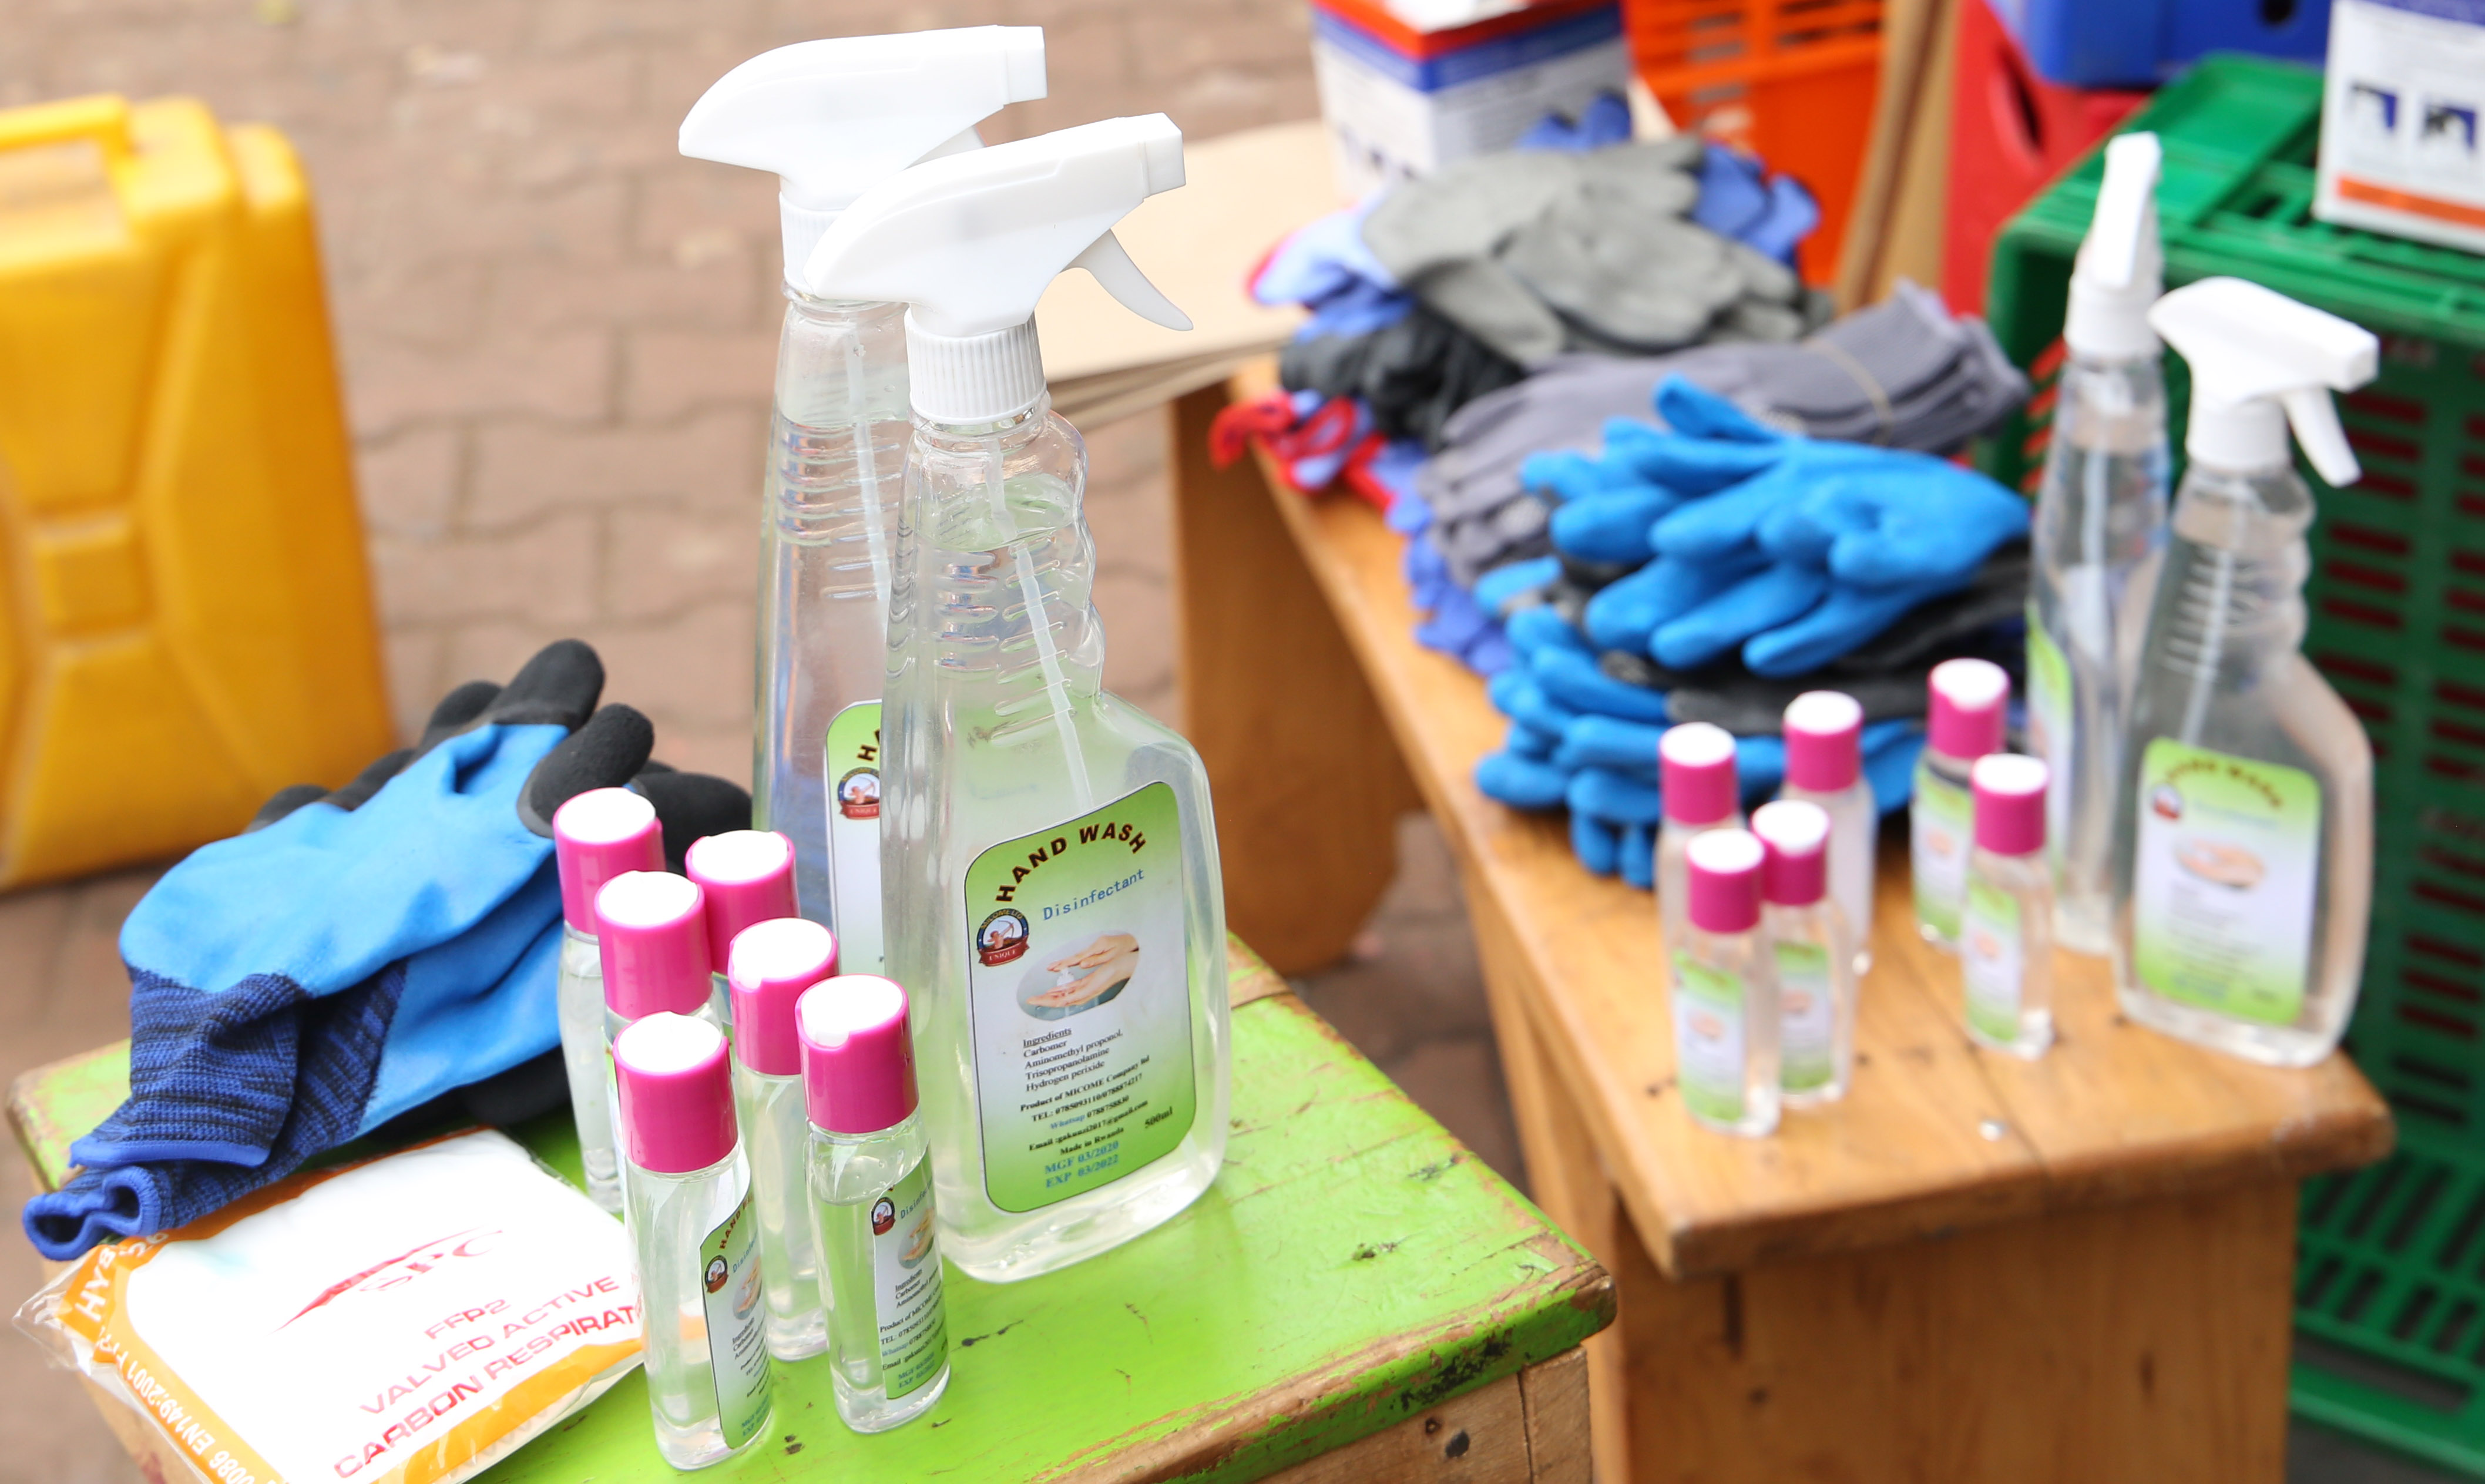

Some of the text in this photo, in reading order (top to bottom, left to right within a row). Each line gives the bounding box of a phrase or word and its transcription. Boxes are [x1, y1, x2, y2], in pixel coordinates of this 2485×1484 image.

[995, 821, 1146, 902] HAND WASH
[1042, 869, 1145, 921] Disinfectant
[1023, 1028, 1072, 1047] Ingredients
[1024, 1040, 1067, 1057] Carbomer
[1025, 1045, 1083, 1069] Aminomethyl
[1026, 1047, 1109, 1080] Trisopropanolamine
[1026, 1060, 1104, 1092] Hydrogen perixide
[1020, 1097, 1052, 1111] Product
[1055, 1093, 1063, 1101] of
[1065, 1079, 1104, 1097] MICOME
[1032, 1110, 1053, 1122] TEL:
[1145, 1106, 1173, 1127] 500ml
[1029, 1139, 1053, 1150] Email
[1060, 1143, 1082, 1154] Made
[1094, 1127, 1124, 1143] Rwanda
[1045, 1140, 1119, 1174] MGF 03/2020
[1046, 1172, 1072, 1188] EXP
[719, 1211, 741, 1249] HAND
[424, 1299, 511, 1339] FFP2
[360, 1275, 620, 1415] VALVED ACTIVE
[333, 1304, 636, 1479] CARBON RESPIRAT
